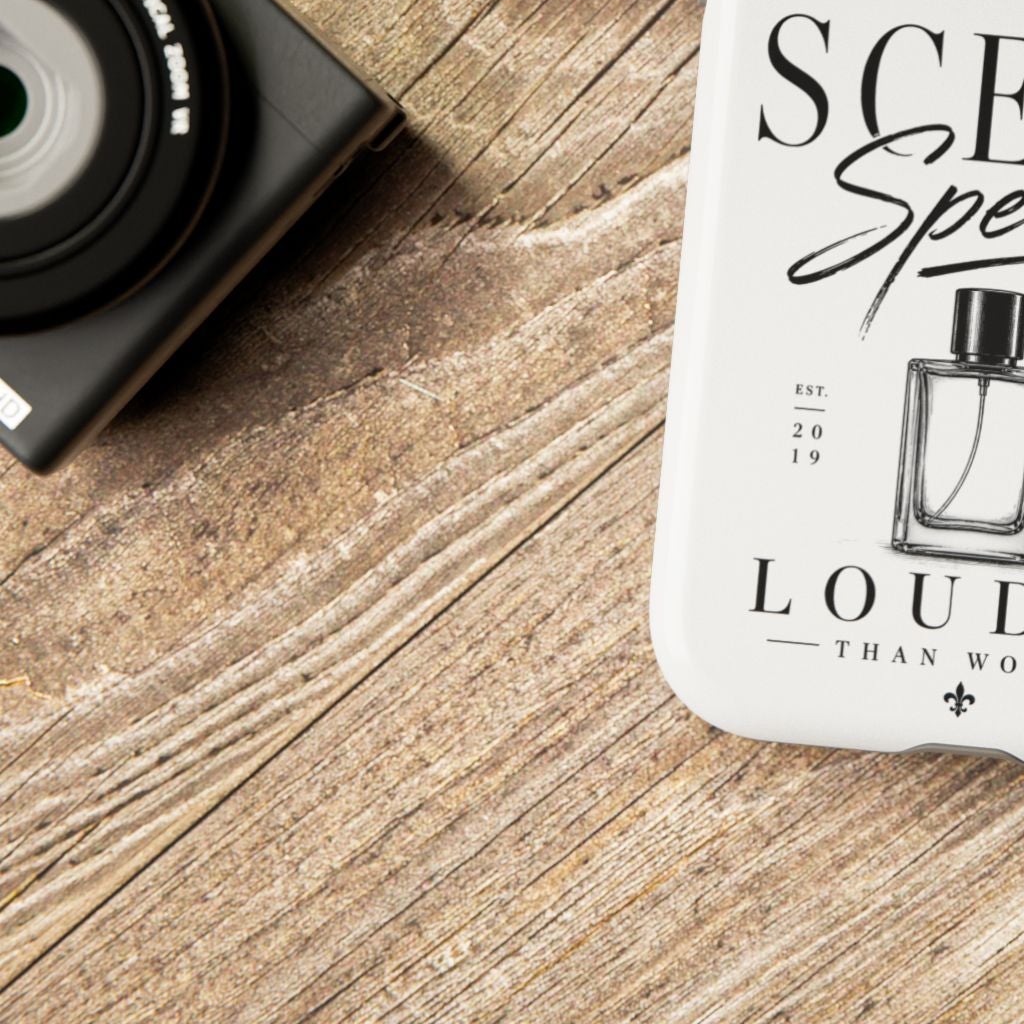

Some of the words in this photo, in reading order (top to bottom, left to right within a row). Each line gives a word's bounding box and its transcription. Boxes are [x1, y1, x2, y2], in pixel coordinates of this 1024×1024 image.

[163, 42, 190, 101] ZOOM
[795, 383, 829, 397] EST.
[792, 422, 823, 440] 20
[791, 448, 820, 465] 19
[835, 639, 937, 666] THAN
